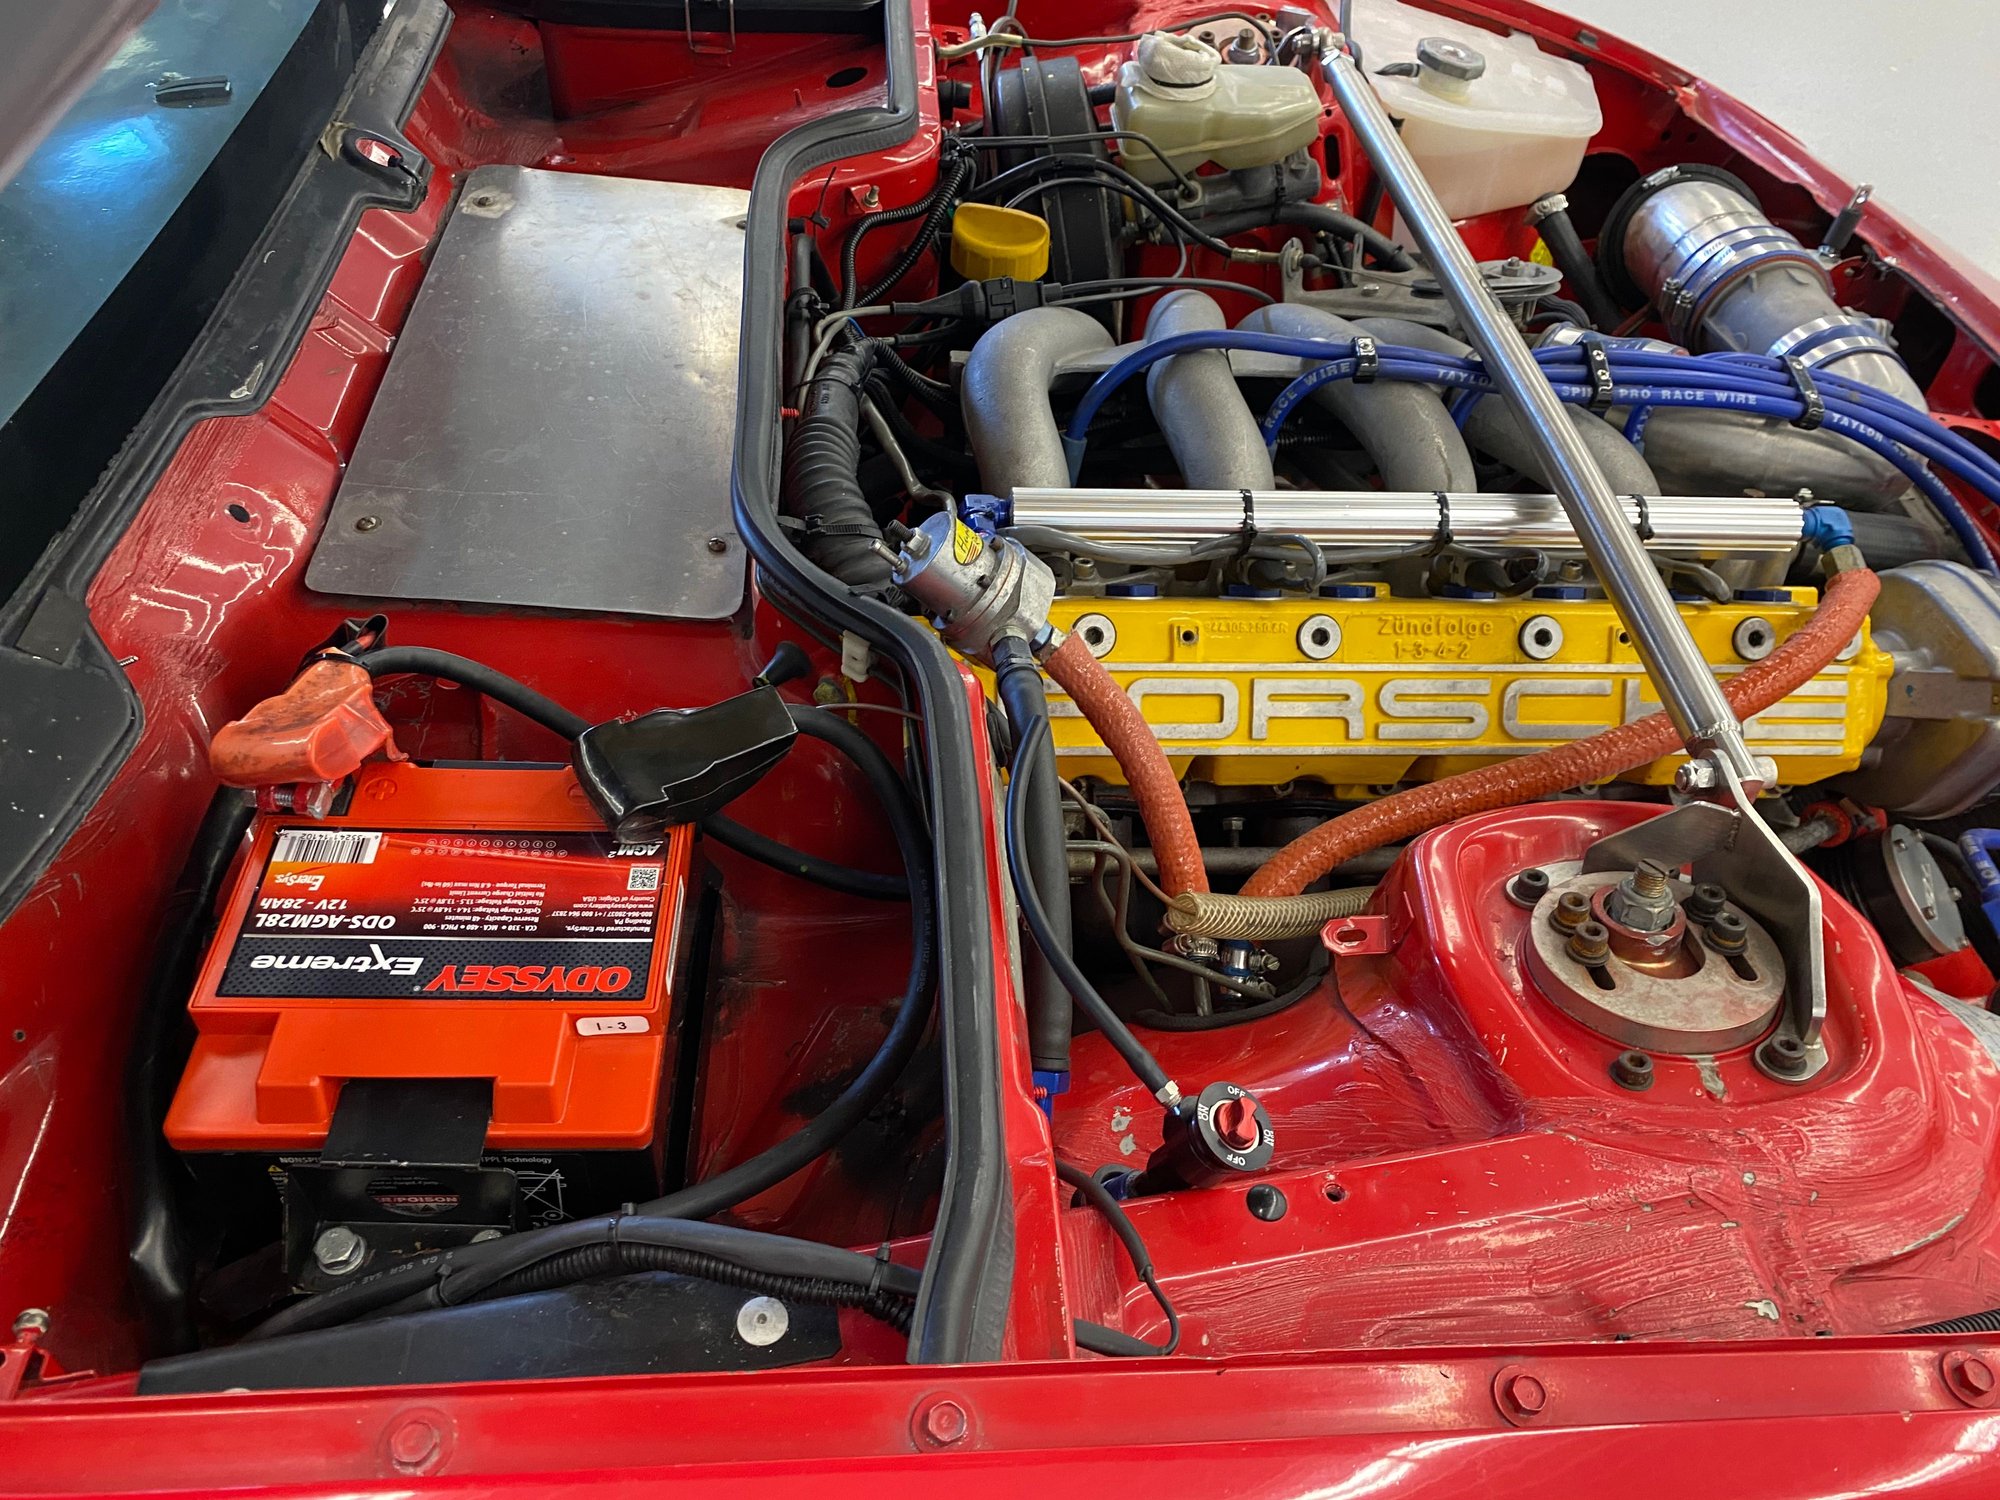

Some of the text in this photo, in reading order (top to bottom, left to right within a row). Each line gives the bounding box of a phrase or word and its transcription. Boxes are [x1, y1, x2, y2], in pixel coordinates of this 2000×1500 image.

[1263, 361, 1351, 429] RACE WIRE
[1618, 388, 1652, 400] PRO
[1661, 390, 1705, 401] RACE
[1714, 391, 1758, 406] WIRE
[1831, 412, 1884, 443] TAYLOR
[1378, 615, 1494, 640] Zündfolge
[1393, 638, 1472, 660] 1-3-4-2
[259, 897, 307, 910] 28Ah
[313, 898, 349, 911] 12V
[474, 898, 503, 906] Voltage:
[502, 898, 526, 906] Charge
[499, 906, 522, 914] Charge
[523, 906, 541, 914] Cyclic
[254, 913, 397, 929] ODS-AGM28L
[485, 914, 513, 922] Capacity
[625, 918, 652, 926] Reading
[606, 925, 651, 933] Manufactured
[250, 943, 424, 976] Extreme
[423, 964, 632, 993] ODYSSEY
[617, 1021, 629, 1032] 3
[1227, 1085, 1246, 1097] OFF
[503, 1156, 553, 1165] Technology
[1226, 1153, 1246, 1166] OFF
[421, 1255, 438, 1265] GA
[445, 1251, 454, 1260] 2
